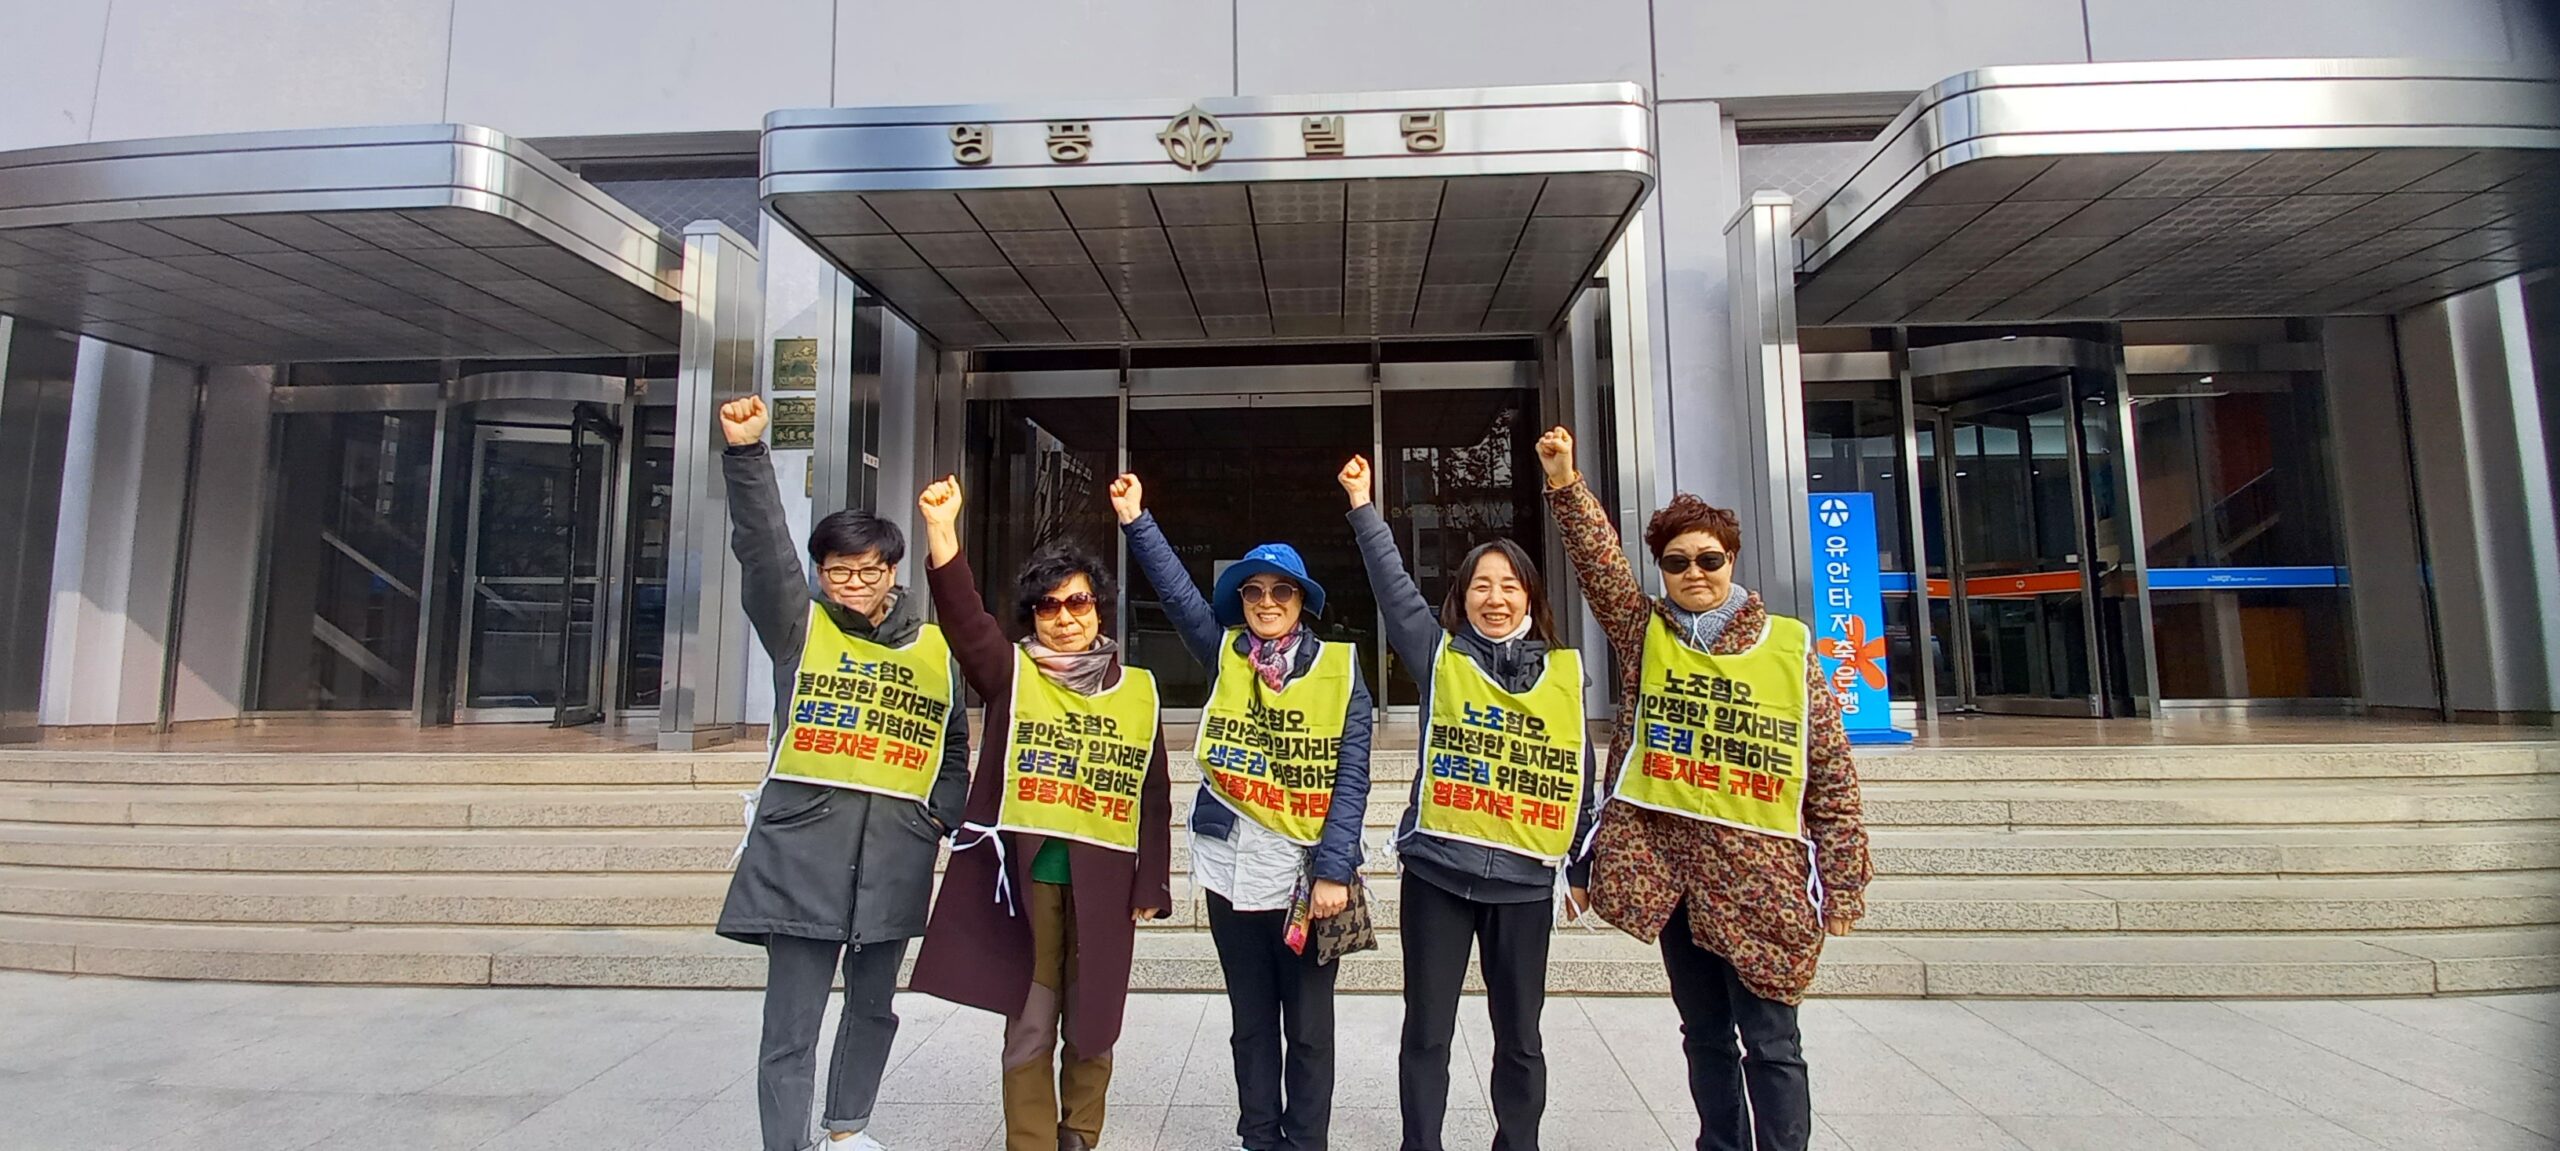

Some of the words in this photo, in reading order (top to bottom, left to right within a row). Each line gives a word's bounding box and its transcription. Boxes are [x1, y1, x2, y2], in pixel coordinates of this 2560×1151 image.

[1825, 536, 1859, 714] 유안타저축은행
[837, 651, 918, 690] 노조혐오,
[1664, 669, 1759, 709] 노조혐오,
[797, 672, 878, 705] 불안정한
[880, 686, 948, 725] 일자리로
[1641, 694, 1708, 728] 안정한
[1713, 706, 1797, 748] 일자리로
[793, 727, 880, 761] 영풍자본
[794, 699, 861, 729] 생존권
[864, 708, 937, 748] 위협하는
[1053, 712, 1123, 741] 조혐오,
[1462, 701, 1551, 743] 노조혐오,
[1017, 748, 1080, 779] 생존권
[1088, 740, 1148, 771] 일자리로
[1207, 743, 1267, 777] 생존권
[1269, 761, 1337, 789] 위협하는
[1430, 724, 1505, 760] 불안정한
[1509, 739, 1579, 775] 일자리로
[1644, 723, 1694, 754] 존권
[1700, 734, 1792, 776] 위협하는
[1431, 752, 1490, 785] 생존권
[1495, 765, 1574, 802] 위협하는
[1728, 768, 1784, 803] 규탄!
[1432, 780, 1515, 820] 영풍자본
[1521, 798, 1566, 831] 규탄!
